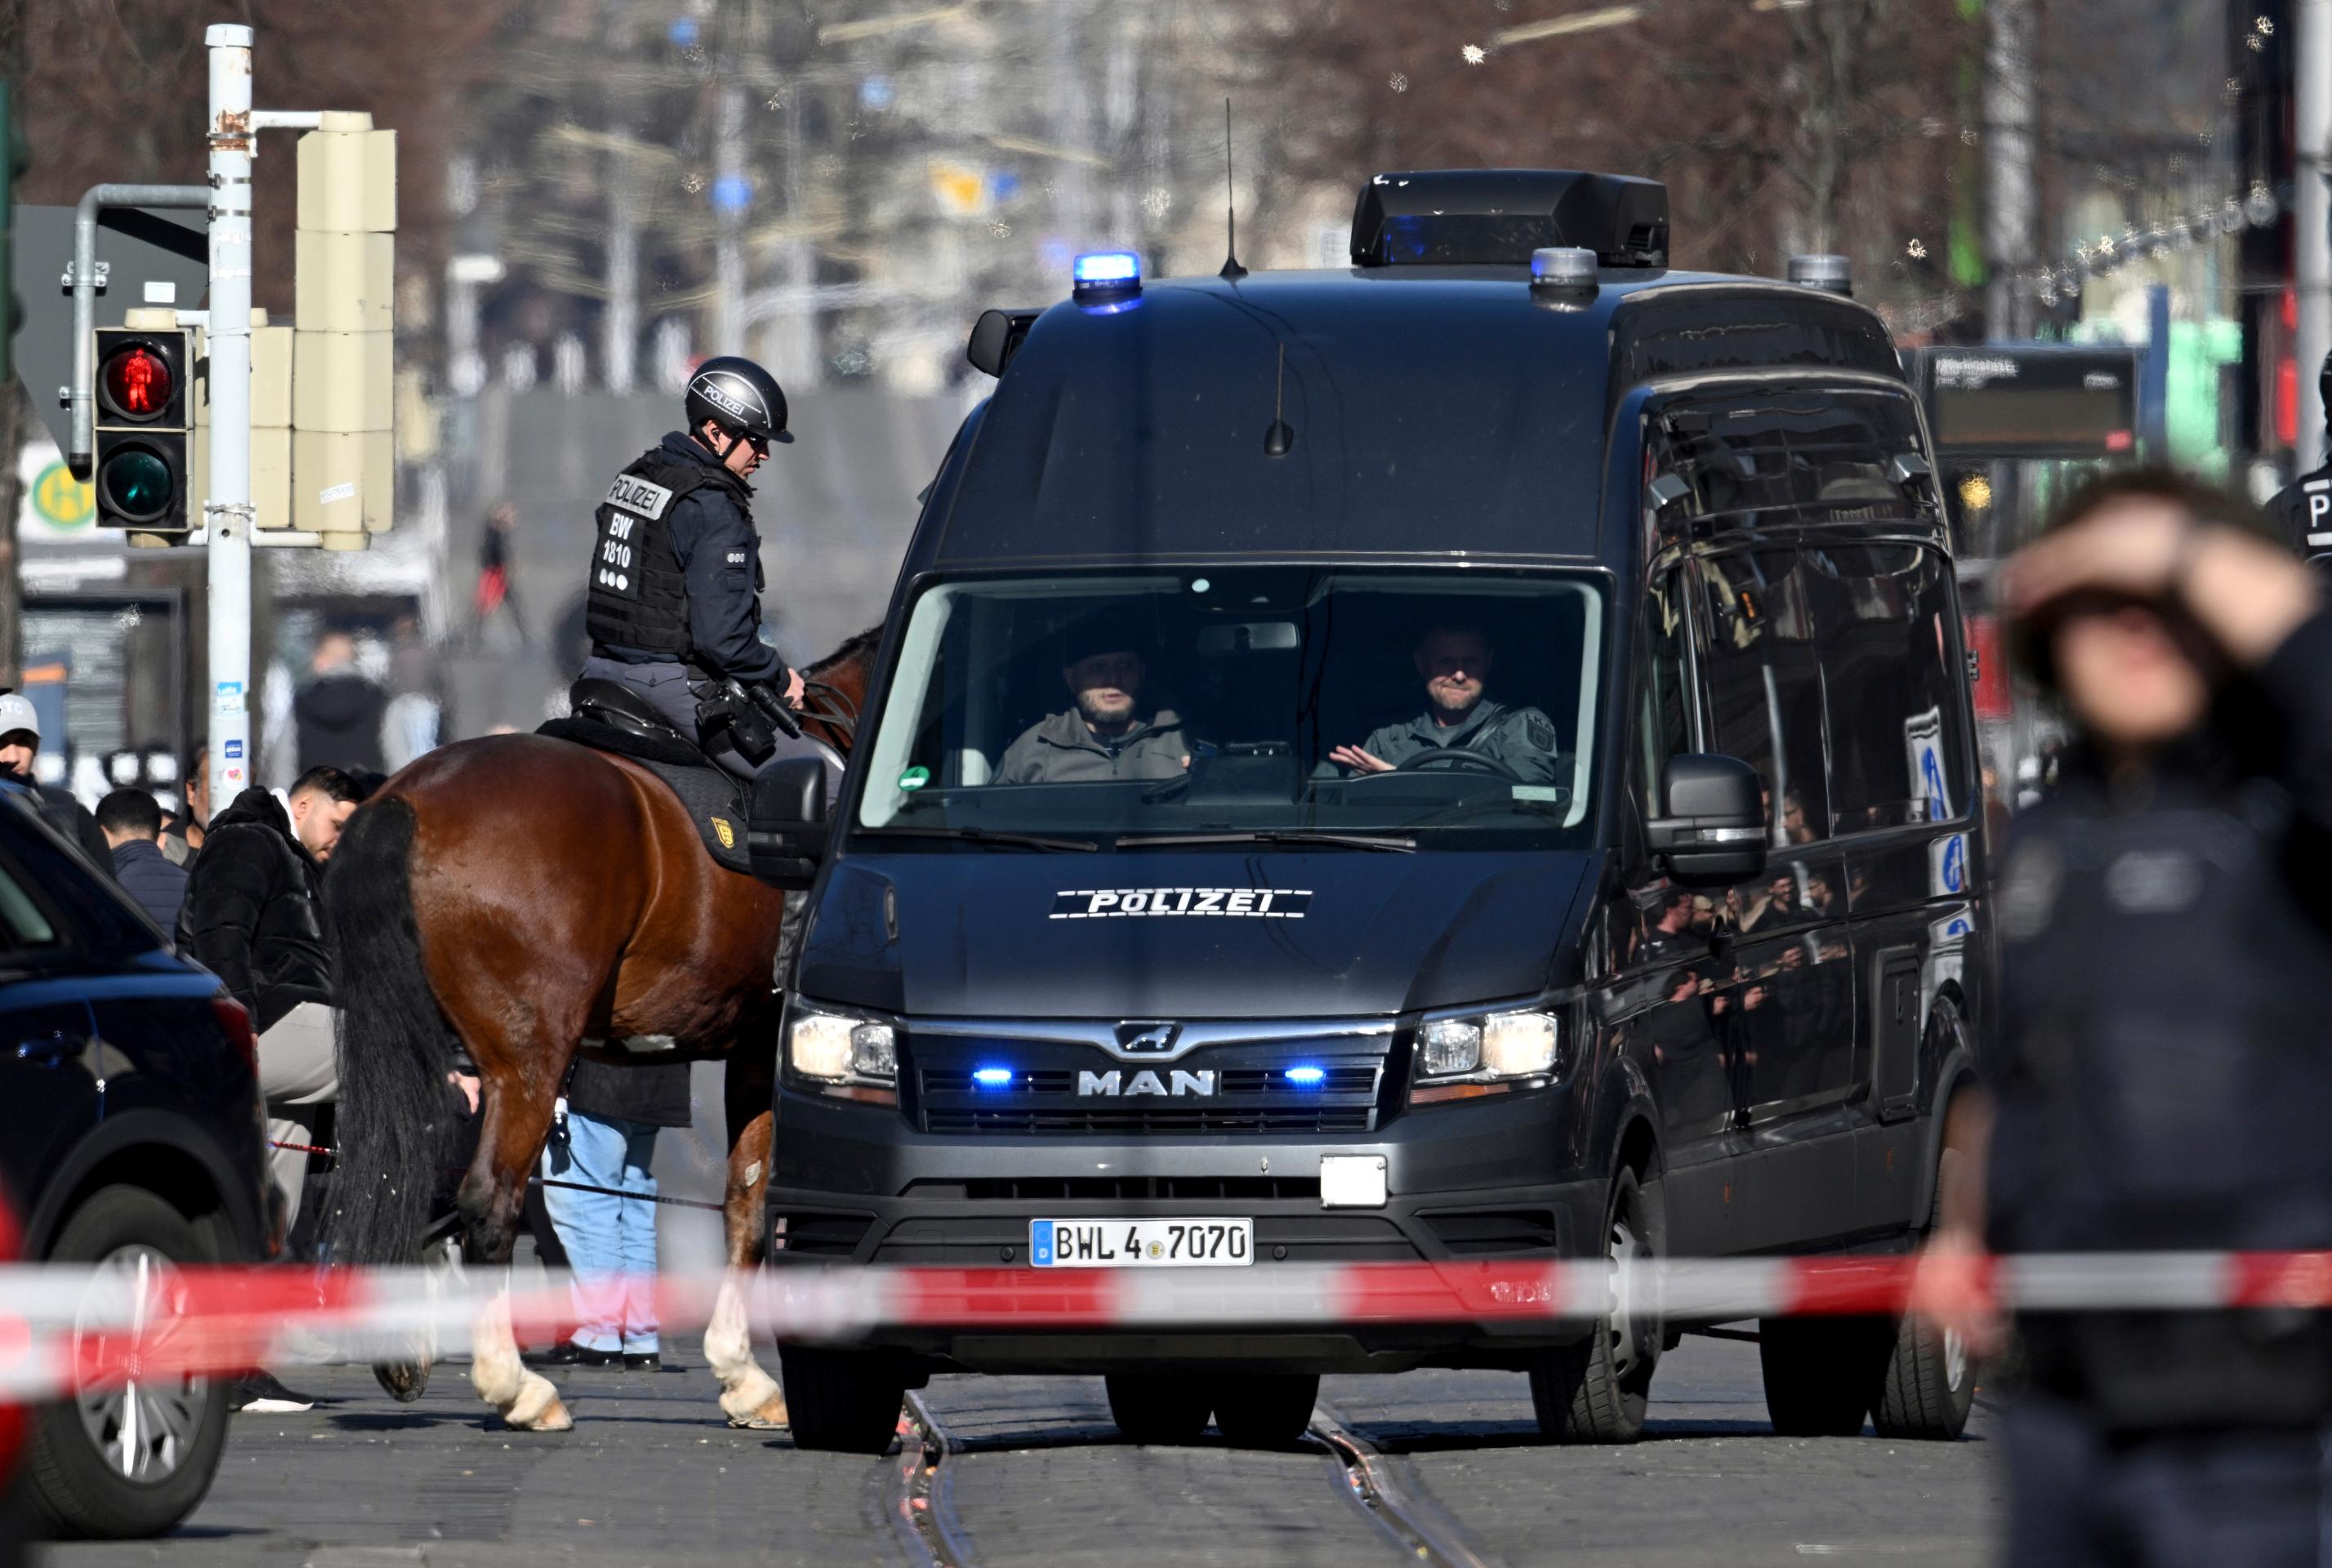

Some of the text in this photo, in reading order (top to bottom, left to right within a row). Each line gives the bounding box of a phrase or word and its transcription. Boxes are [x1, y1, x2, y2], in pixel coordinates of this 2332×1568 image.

[704, 385, 744, 415] POLIZEI
[609, 479, 661, 511] POLIZEI
[609, 512, 634, 540] BW
[603, 539, 631, 568] 1810
[0, 701, 24, 715] YC
[1087, 891, 1273, 913] POLIZEI
[1077, 1070, 1215, 1096] MAN
[1038, 1248, 1048, 1258] D
[1056, 1226, 1246, 1259] BWL 4 7070
